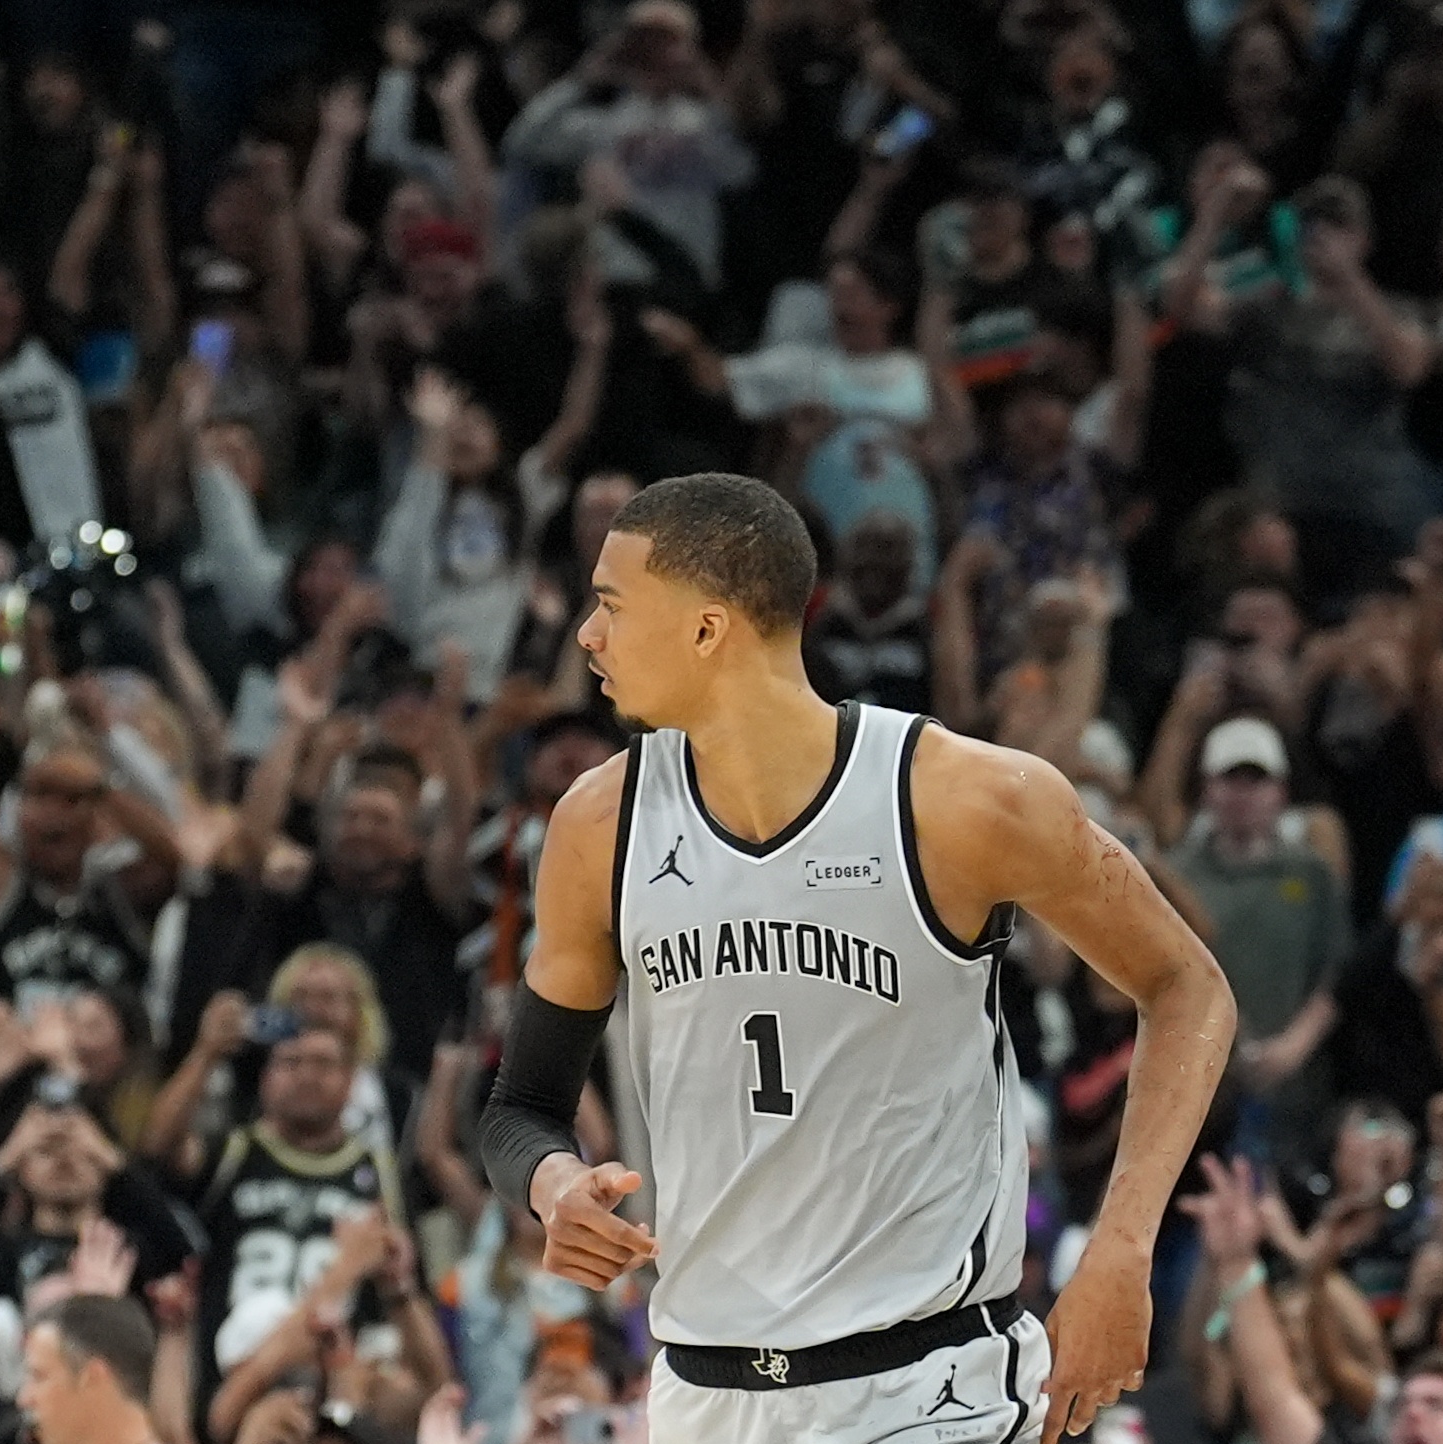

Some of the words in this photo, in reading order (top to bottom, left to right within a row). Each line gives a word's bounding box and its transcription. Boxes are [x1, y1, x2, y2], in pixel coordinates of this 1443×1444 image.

[815, 865, 871, 879] LEDGER
[639, 925, 706, 996] SAN
[712, 918, 901, 1007] ANTONIO
[740, 1010, 796, 1120] 1
